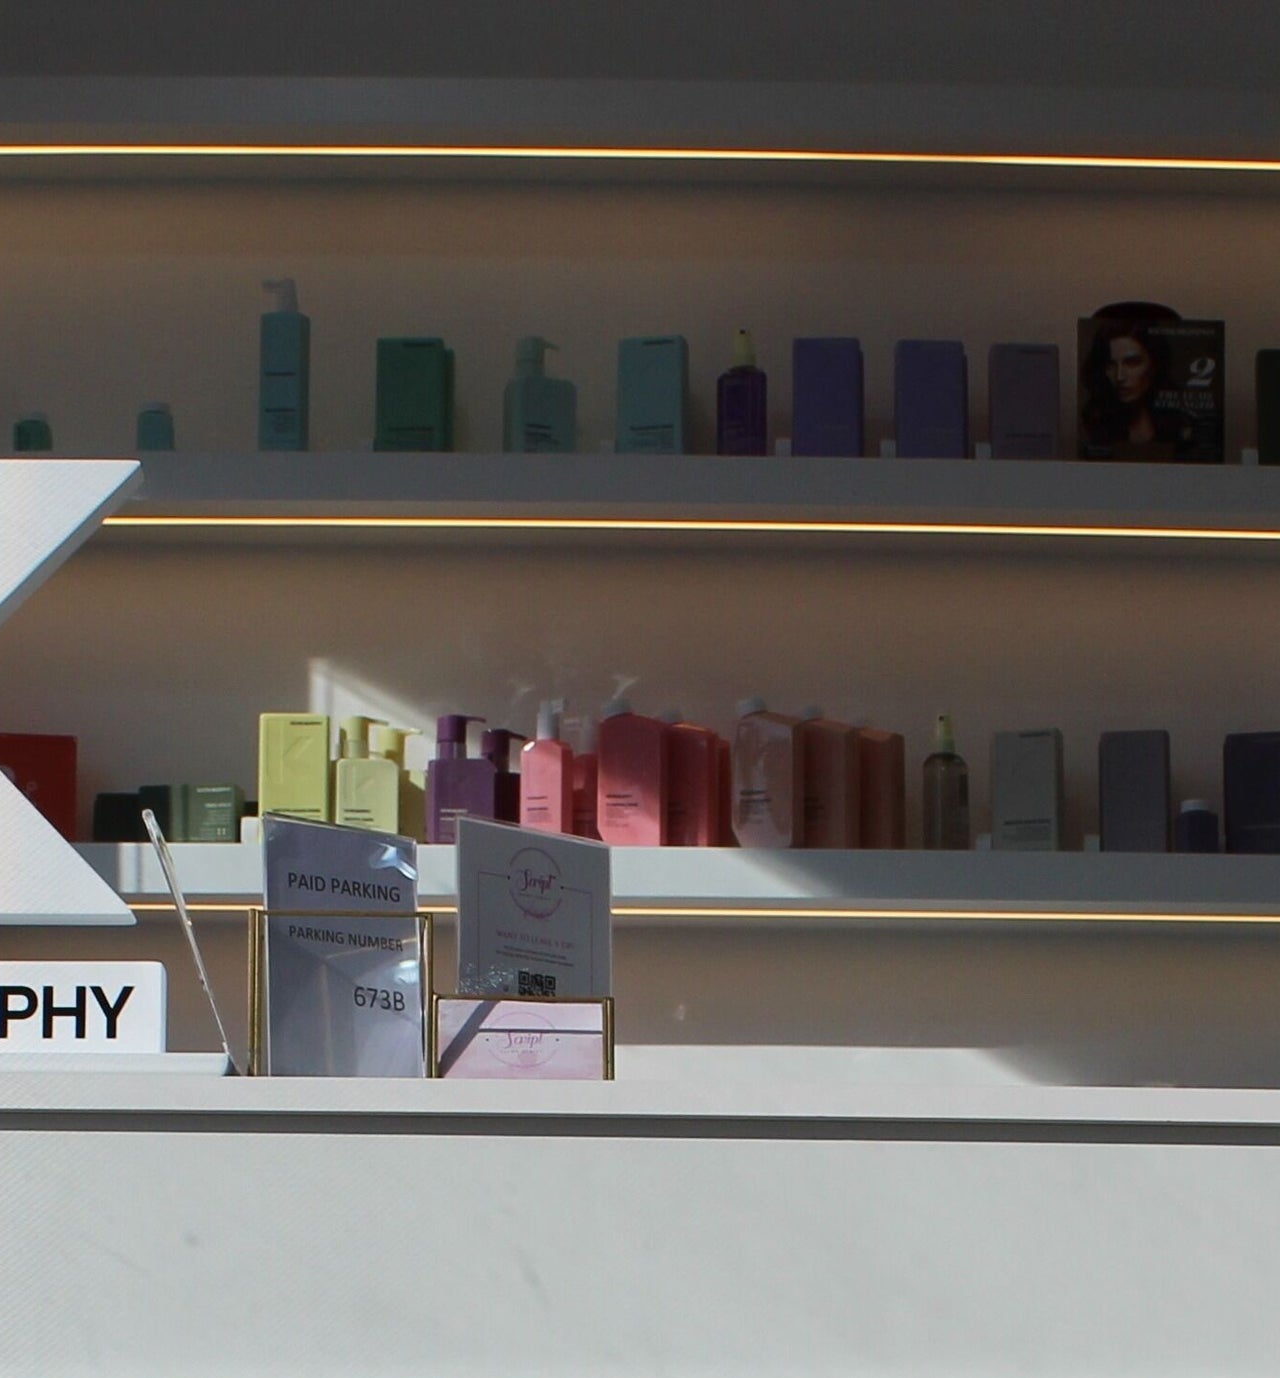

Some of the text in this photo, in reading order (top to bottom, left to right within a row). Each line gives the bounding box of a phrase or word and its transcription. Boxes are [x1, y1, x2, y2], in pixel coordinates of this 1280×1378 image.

[287, 871, 401, 903] PAID PARKING
[288, 925, 404, 953] PARKING NUMBER
[354, 986, 406, 1012] 673B
